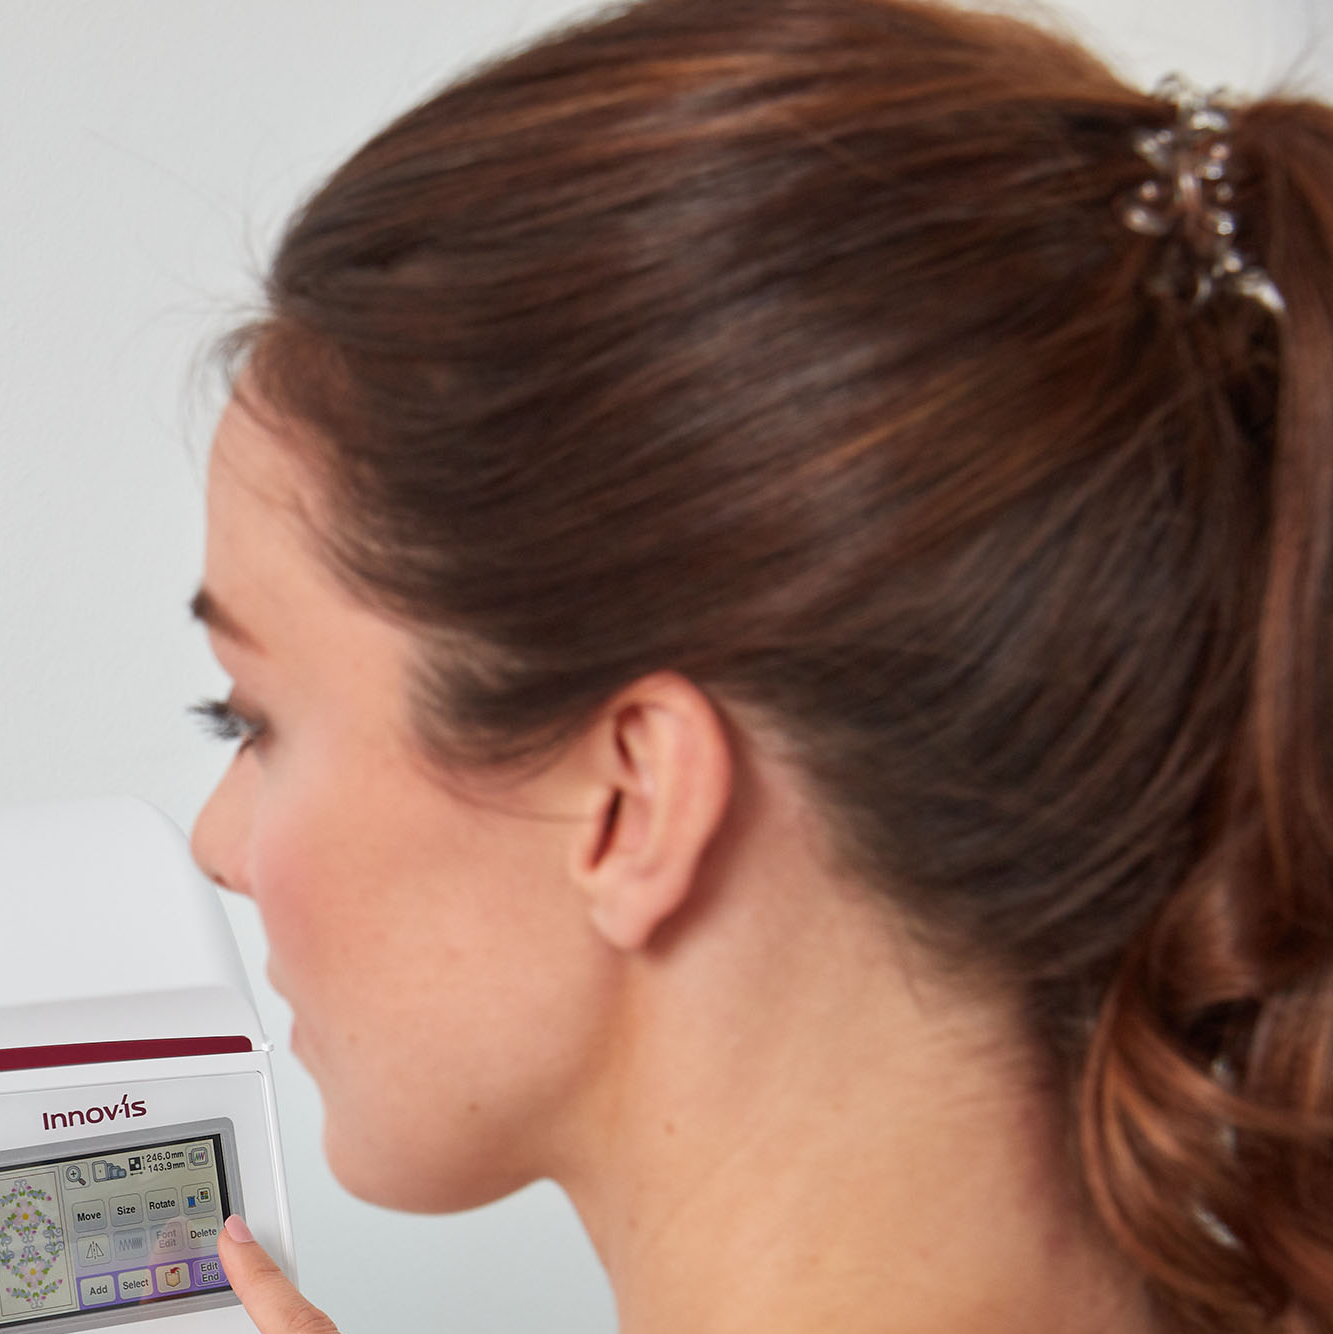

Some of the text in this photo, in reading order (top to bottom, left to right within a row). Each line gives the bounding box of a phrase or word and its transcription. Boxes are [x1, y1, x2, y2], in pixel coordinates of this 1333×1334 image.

[149, 1199, 175, 1210] Rotate
[116, 1206, 136, 1215] Size
[77, 1211, 102, 1222] Move
[156, 1229, 177, 1239] Font
[190, 1227, 217, 1239] Delete
[159, 1238, 177, 1248] Edit
[200, 1261, 219, 1272] Edit
[202, 1272, 219, 1282] End
[122, 1279, 149, 1290] Select
[89, 1285, 108, 1296] Add
